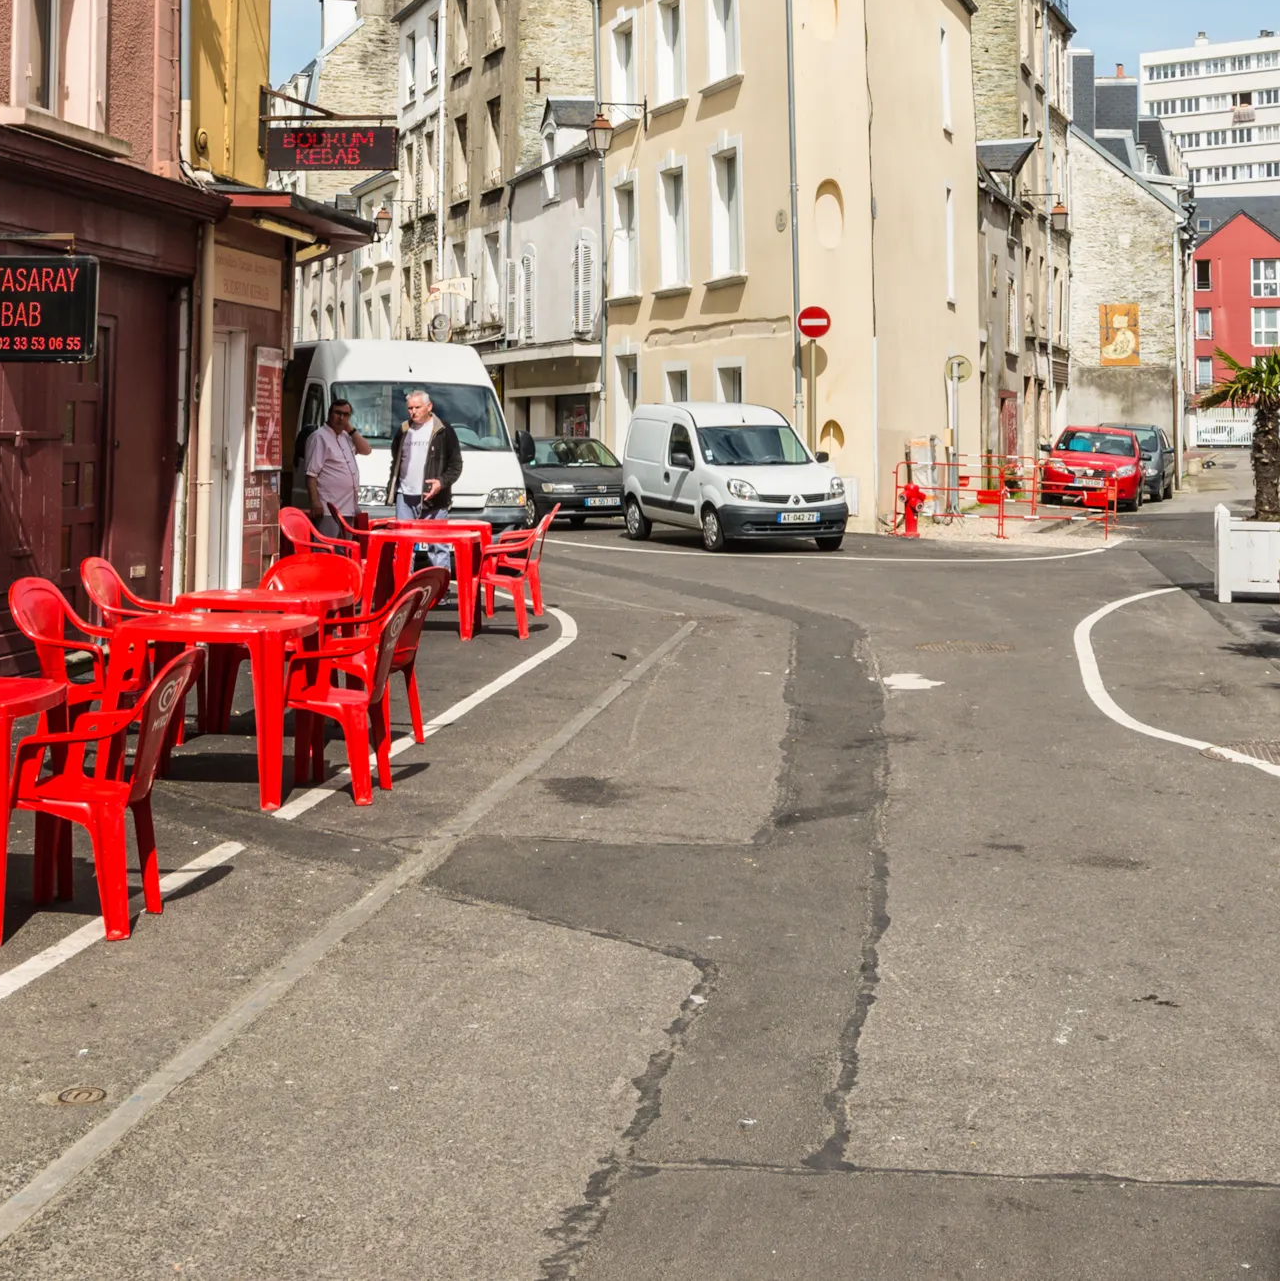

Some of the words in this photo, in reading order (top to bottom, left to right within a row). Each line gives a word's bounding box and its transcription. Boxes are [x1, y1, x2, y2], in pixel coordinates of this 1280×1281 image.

[295, 148, 361, 165] KEBAB
[13, 336, 28, 350] 33
[31, 336, 46, 350] 53
[48, 336, 63, 350] 06
[66, 336, 81, 350] 55
[245, 487, 261, 497] VENTE
